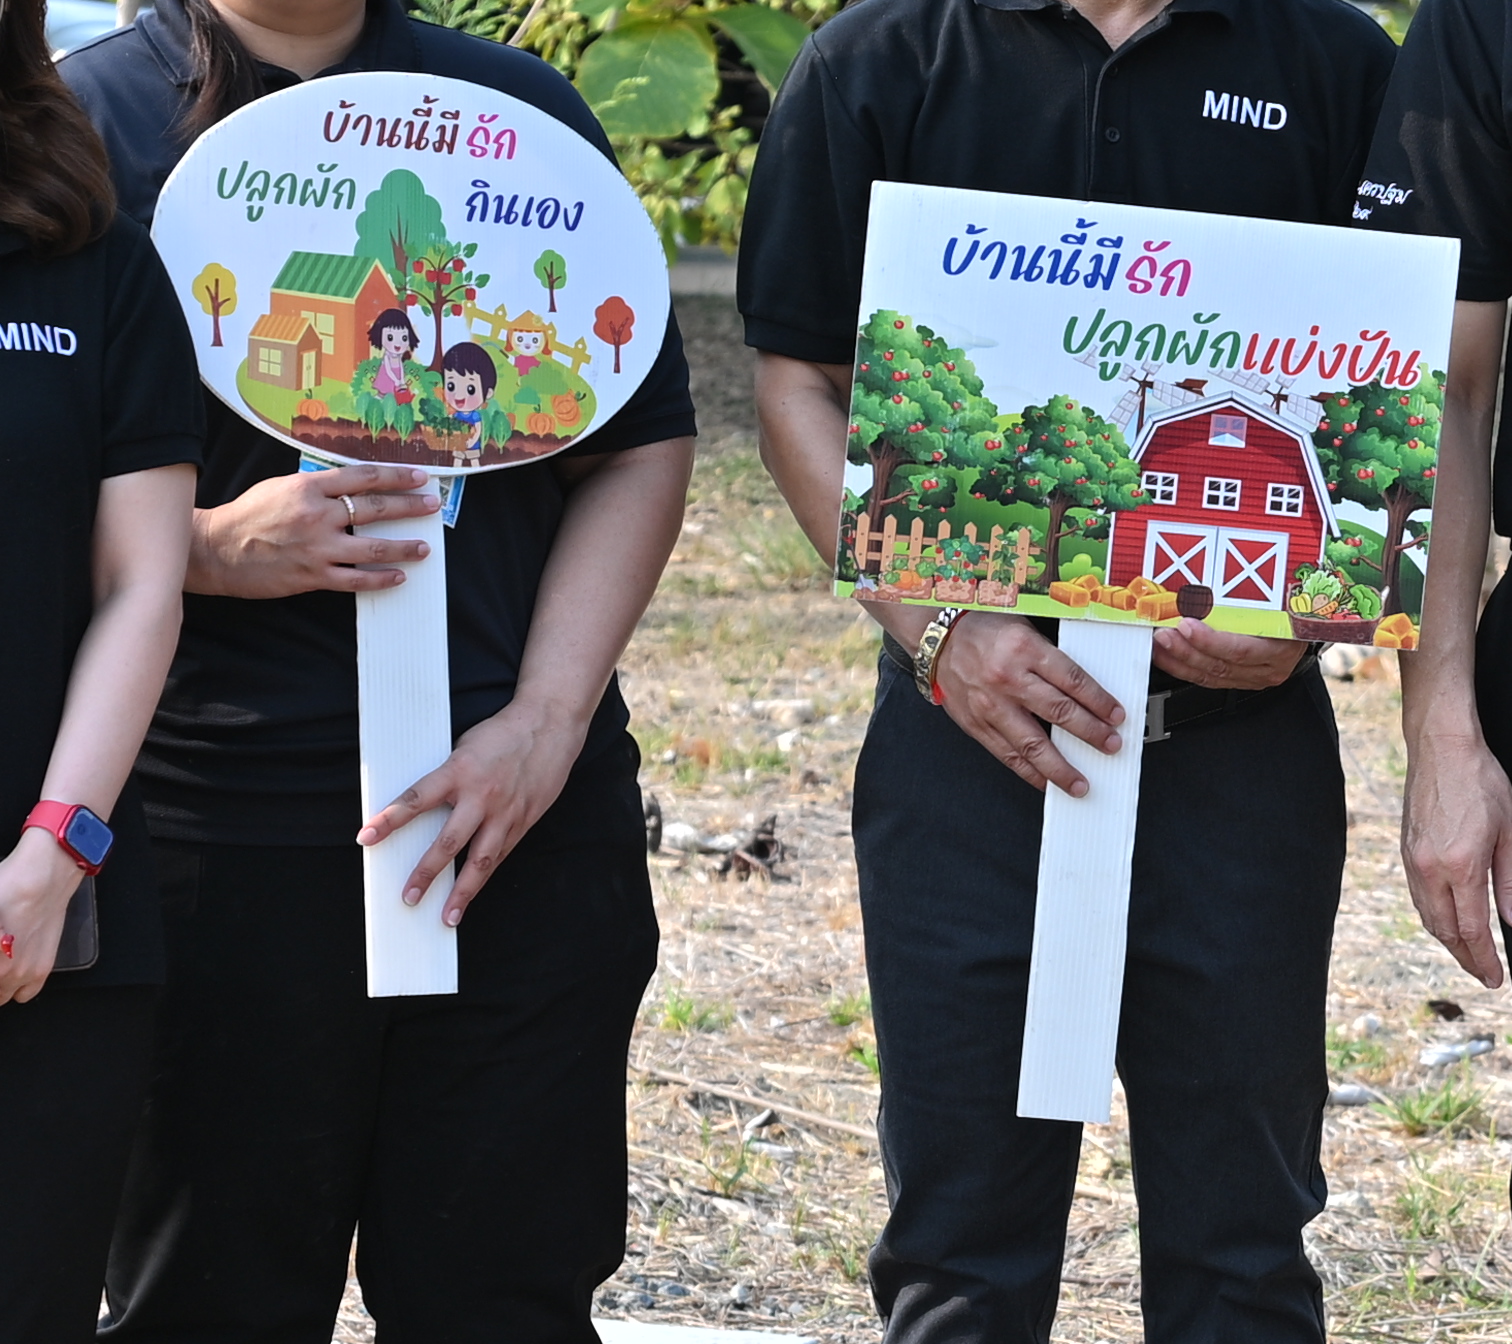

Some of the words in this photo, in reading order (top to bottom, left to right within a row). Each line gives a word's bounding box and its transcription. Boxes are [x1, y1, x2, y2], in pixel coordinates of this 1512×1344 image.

[1202, 89, 1288, 131] MIND
[464, 178, 585, 233] กินเอง
